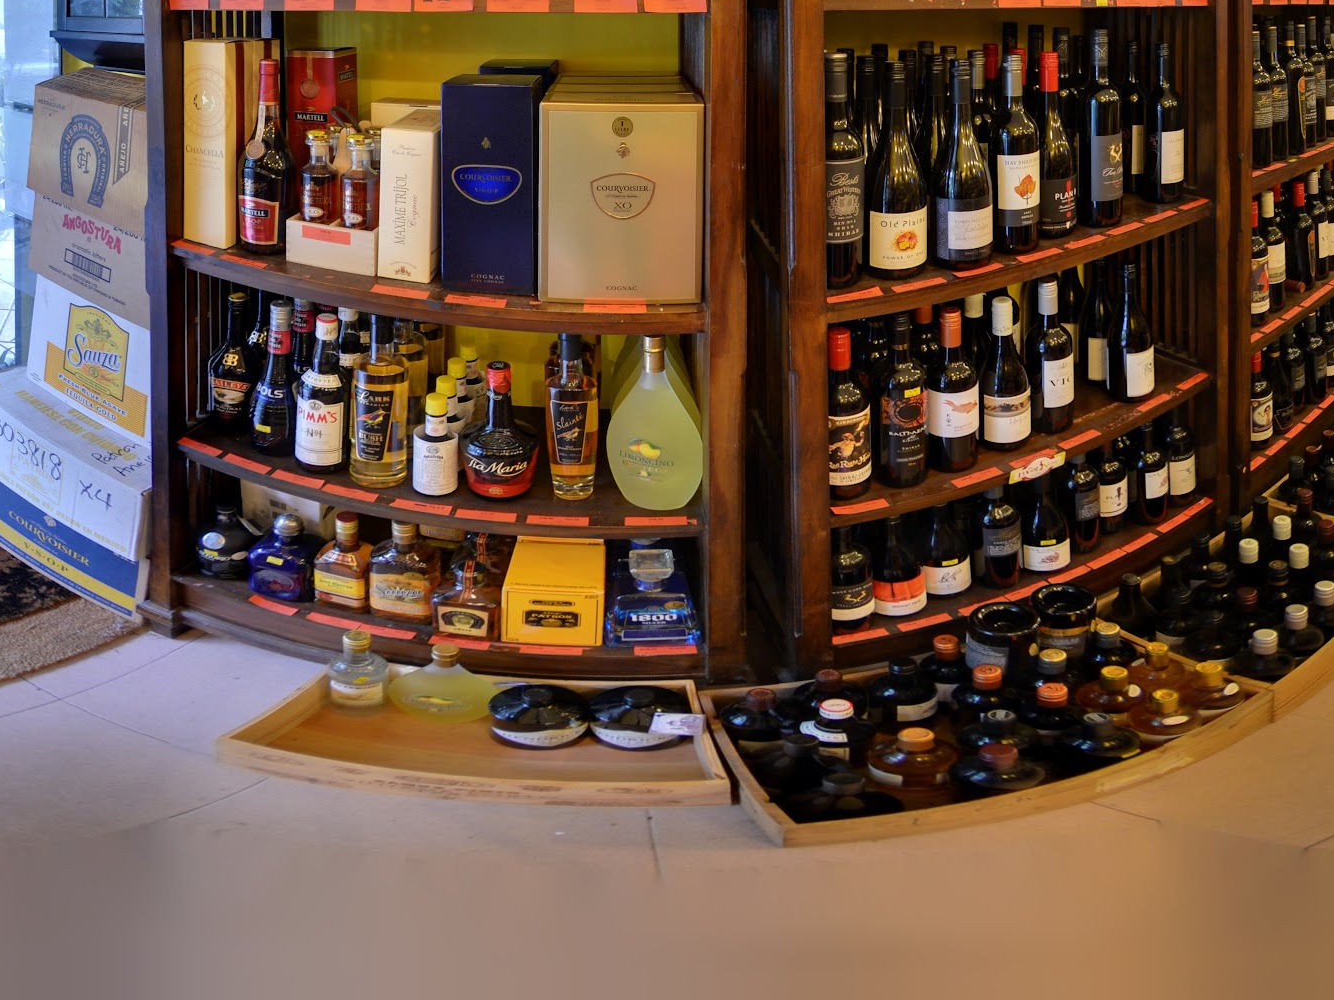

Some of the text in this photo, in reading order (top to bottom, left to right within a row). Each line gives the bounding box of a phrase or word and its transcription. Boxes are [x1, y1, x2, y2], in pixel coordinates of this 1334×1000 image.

[296, 113, 325, 122] MARTELL
[65, 123, 105, 155] HERRADURA
[459, 173, 512, 184] COURVOISIER
[1054, 190, 1074, 201] PLAN
[613, 201, 632, 209] XO
[62, 213, 122, 255] ANGOSTURA
[71, 243, 92, 256] aromatic
[67, 333, 121, 373] Sauza
[58, 373, 127, 416] FRESH BLUE AGAVE
[256, 381, 285, 399] BOLS
[65, 387, 94, 409] TEQUILA
[96, 406, 117, 421] GOLD
[298, 407, 338, 424] PIMM'S
[484, 460, 528, 475] Maria
[619, 450, 674, 468] LIMONCINO
[8, 509, 91, 568] COURVOISIER
[631, 613, 678, 623] 1800
